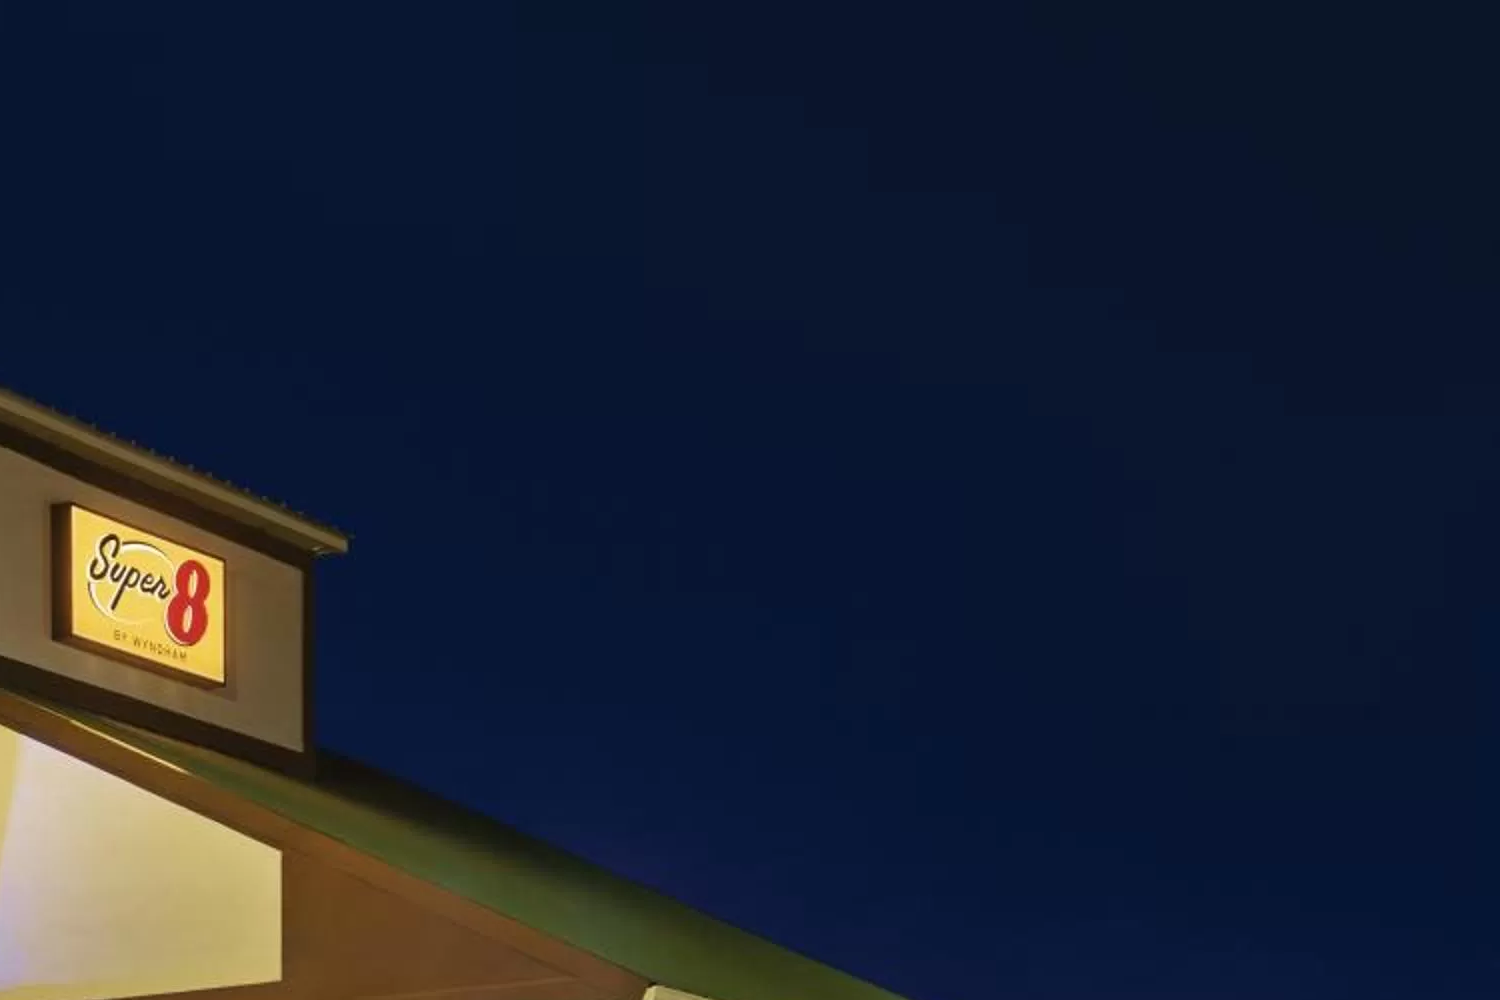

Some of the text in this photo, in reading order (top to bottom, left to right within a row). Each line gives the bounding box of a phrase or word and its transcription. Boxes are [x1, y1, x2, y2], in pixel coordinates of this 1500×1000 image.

[89, 533, 211, 647] Super 8
[133, 635, 187, 659] WYNDHAM
